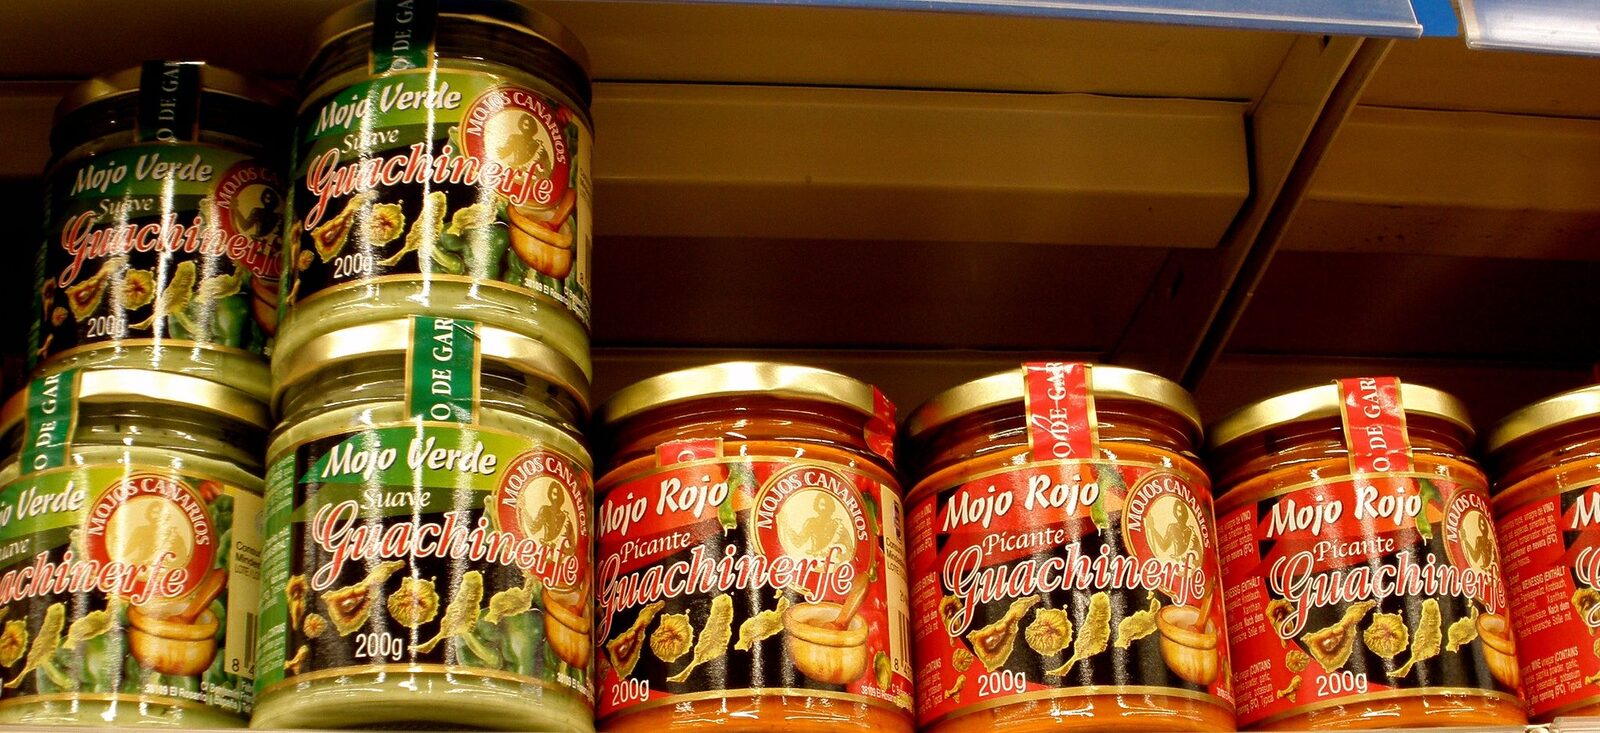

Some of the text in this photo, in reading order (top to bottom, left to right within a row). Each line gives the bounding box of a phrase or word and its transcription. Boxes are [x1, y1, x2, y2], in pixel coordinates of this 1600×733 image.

[392, 29, 412, 51] DE
[158, 98, 177, 120] DE
[314, 82, 462, 136] Mojo Verde
[466, 89, 566, 164] MOJOS CANARIOS
[341, 128, 400, 154] Suave
[71, 154, 213, 197] Mojo Verde
[217, 167, 257, 209] MOJOS
[304, 142, 554, 231] Guachinerfe
[97, 197, 153, 220] Suave
[333, 252, 374, 279] 200g
[87, 315, 127, 338] 200g
[430, 318, 454, 421] O DE GAR
[33, 373, 62, 471] O DE GAR
[1049, 408, 1069, 434] DE
[1366, 425, 1387, 450] DE
[321, 437, 497, 481] Mojo Verde
[1052, 441, 1072, 458] O
[1372, 457, 1391, 472] O
[16, 481, 85, 520] Verde
[88, 480, 138, 537] MOJOS
[141, 478, 210, 547] CANARIOS
[361, 488, 431, 510] Suave
[502, 456, 587, 537] MOJOS CANARIOS
[598, 475, 729, 538] Mojo Rojo
[756, 473, 802, 530] MOJOS
[803, 471, 868, 542] CANARIOS
[942, 474, 1100, 532] Mojo Rojo
[1128, 479, 1163, 532] MOJOS
[1163, 478, 1210, 549] CANARIOS
[1267, 486, 1422, 538] Mojo Rojo
[1446, 494, 1470, 543] MOJOS
[311, 500, 580, 591] Guachinerfe
[620, 530, 692, 565] Picante
[981, 529, 1065, 556] Picante
[1314, 537, 1395, 562] Picante
[596, 544, 855, 646] Guachinerfe
[942, 544, 1207, 637] Guachinerfe
[1269, 550, 1505, 639] Guachinerfe
[355, 633, 403, 661] 200g
[611, 677, 650, 707] 200g
[977, 669, 1027, 698] 200g
[1315, 670, 1369, 697] 200g
